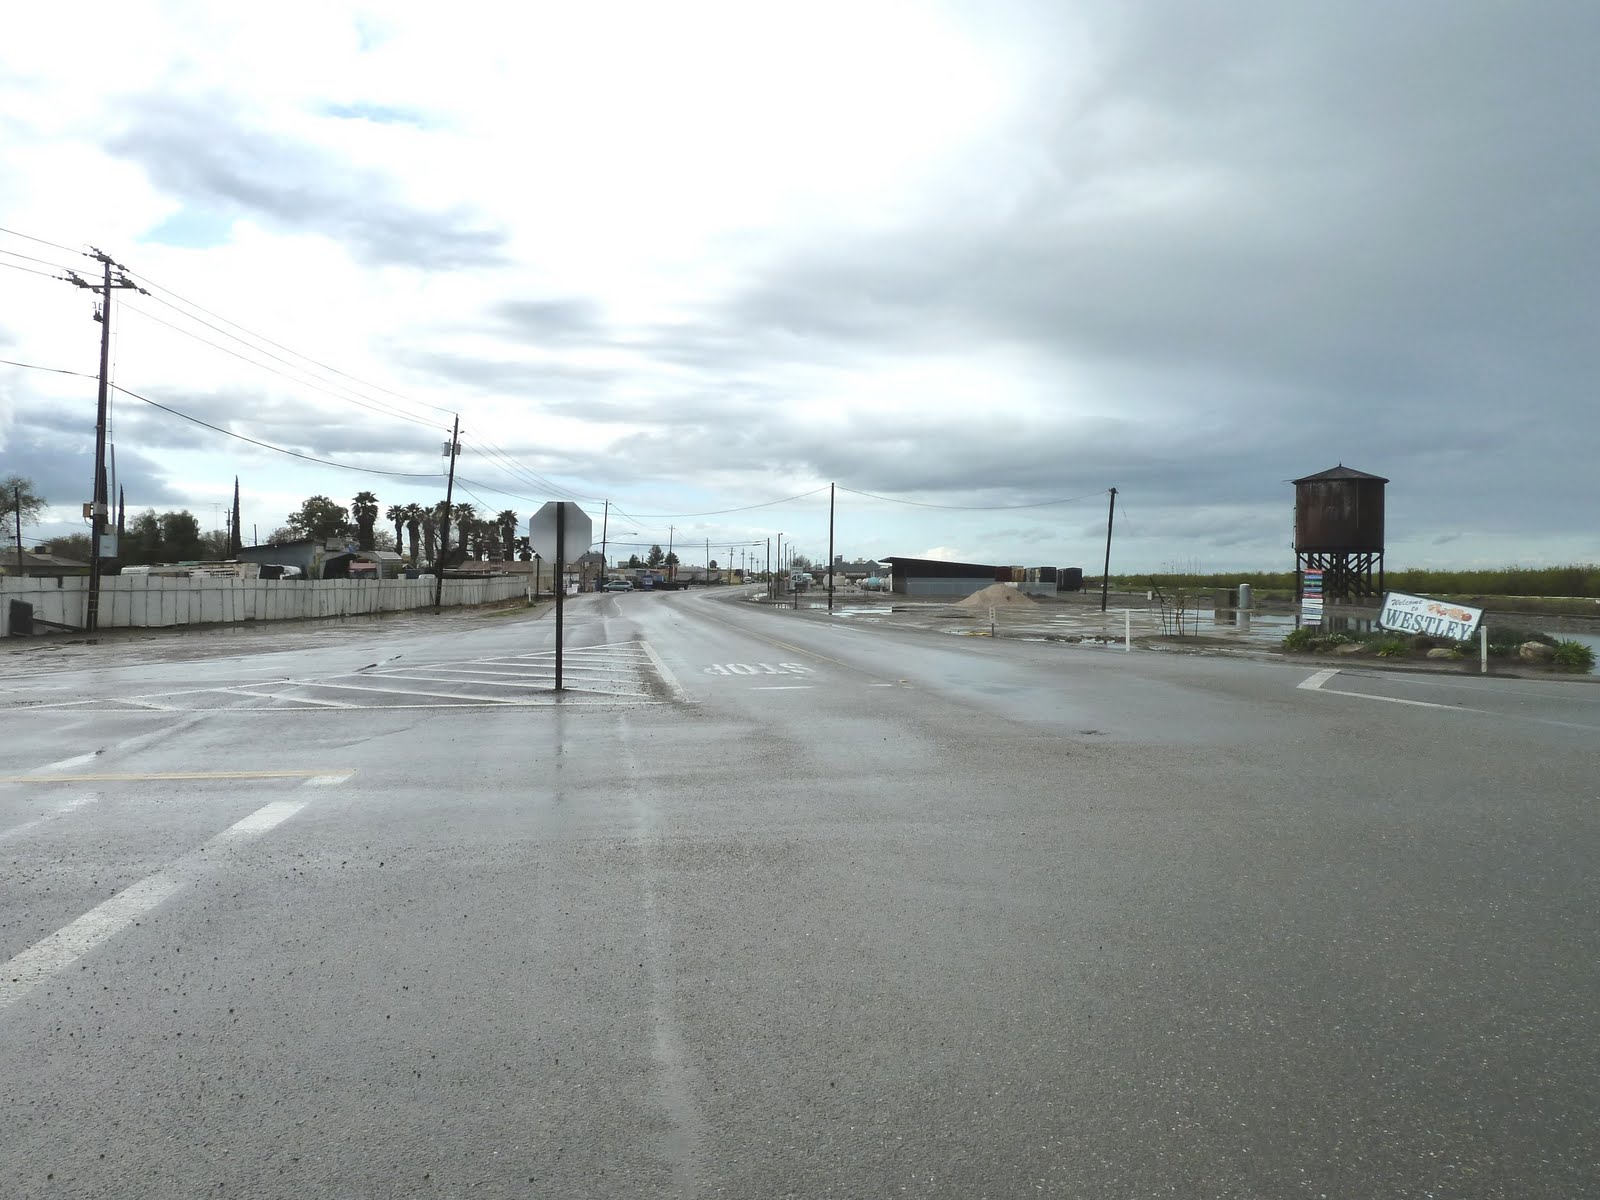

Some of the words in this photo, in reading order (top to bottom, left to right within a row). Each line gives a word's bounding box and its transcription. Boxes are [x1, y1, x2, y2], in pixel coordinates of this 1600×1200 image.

[1391, 598, 1423, 607] Welcome
[1385, 608, 1473, 641] WESTLEY
[703, 663, 816, 676] STOP
